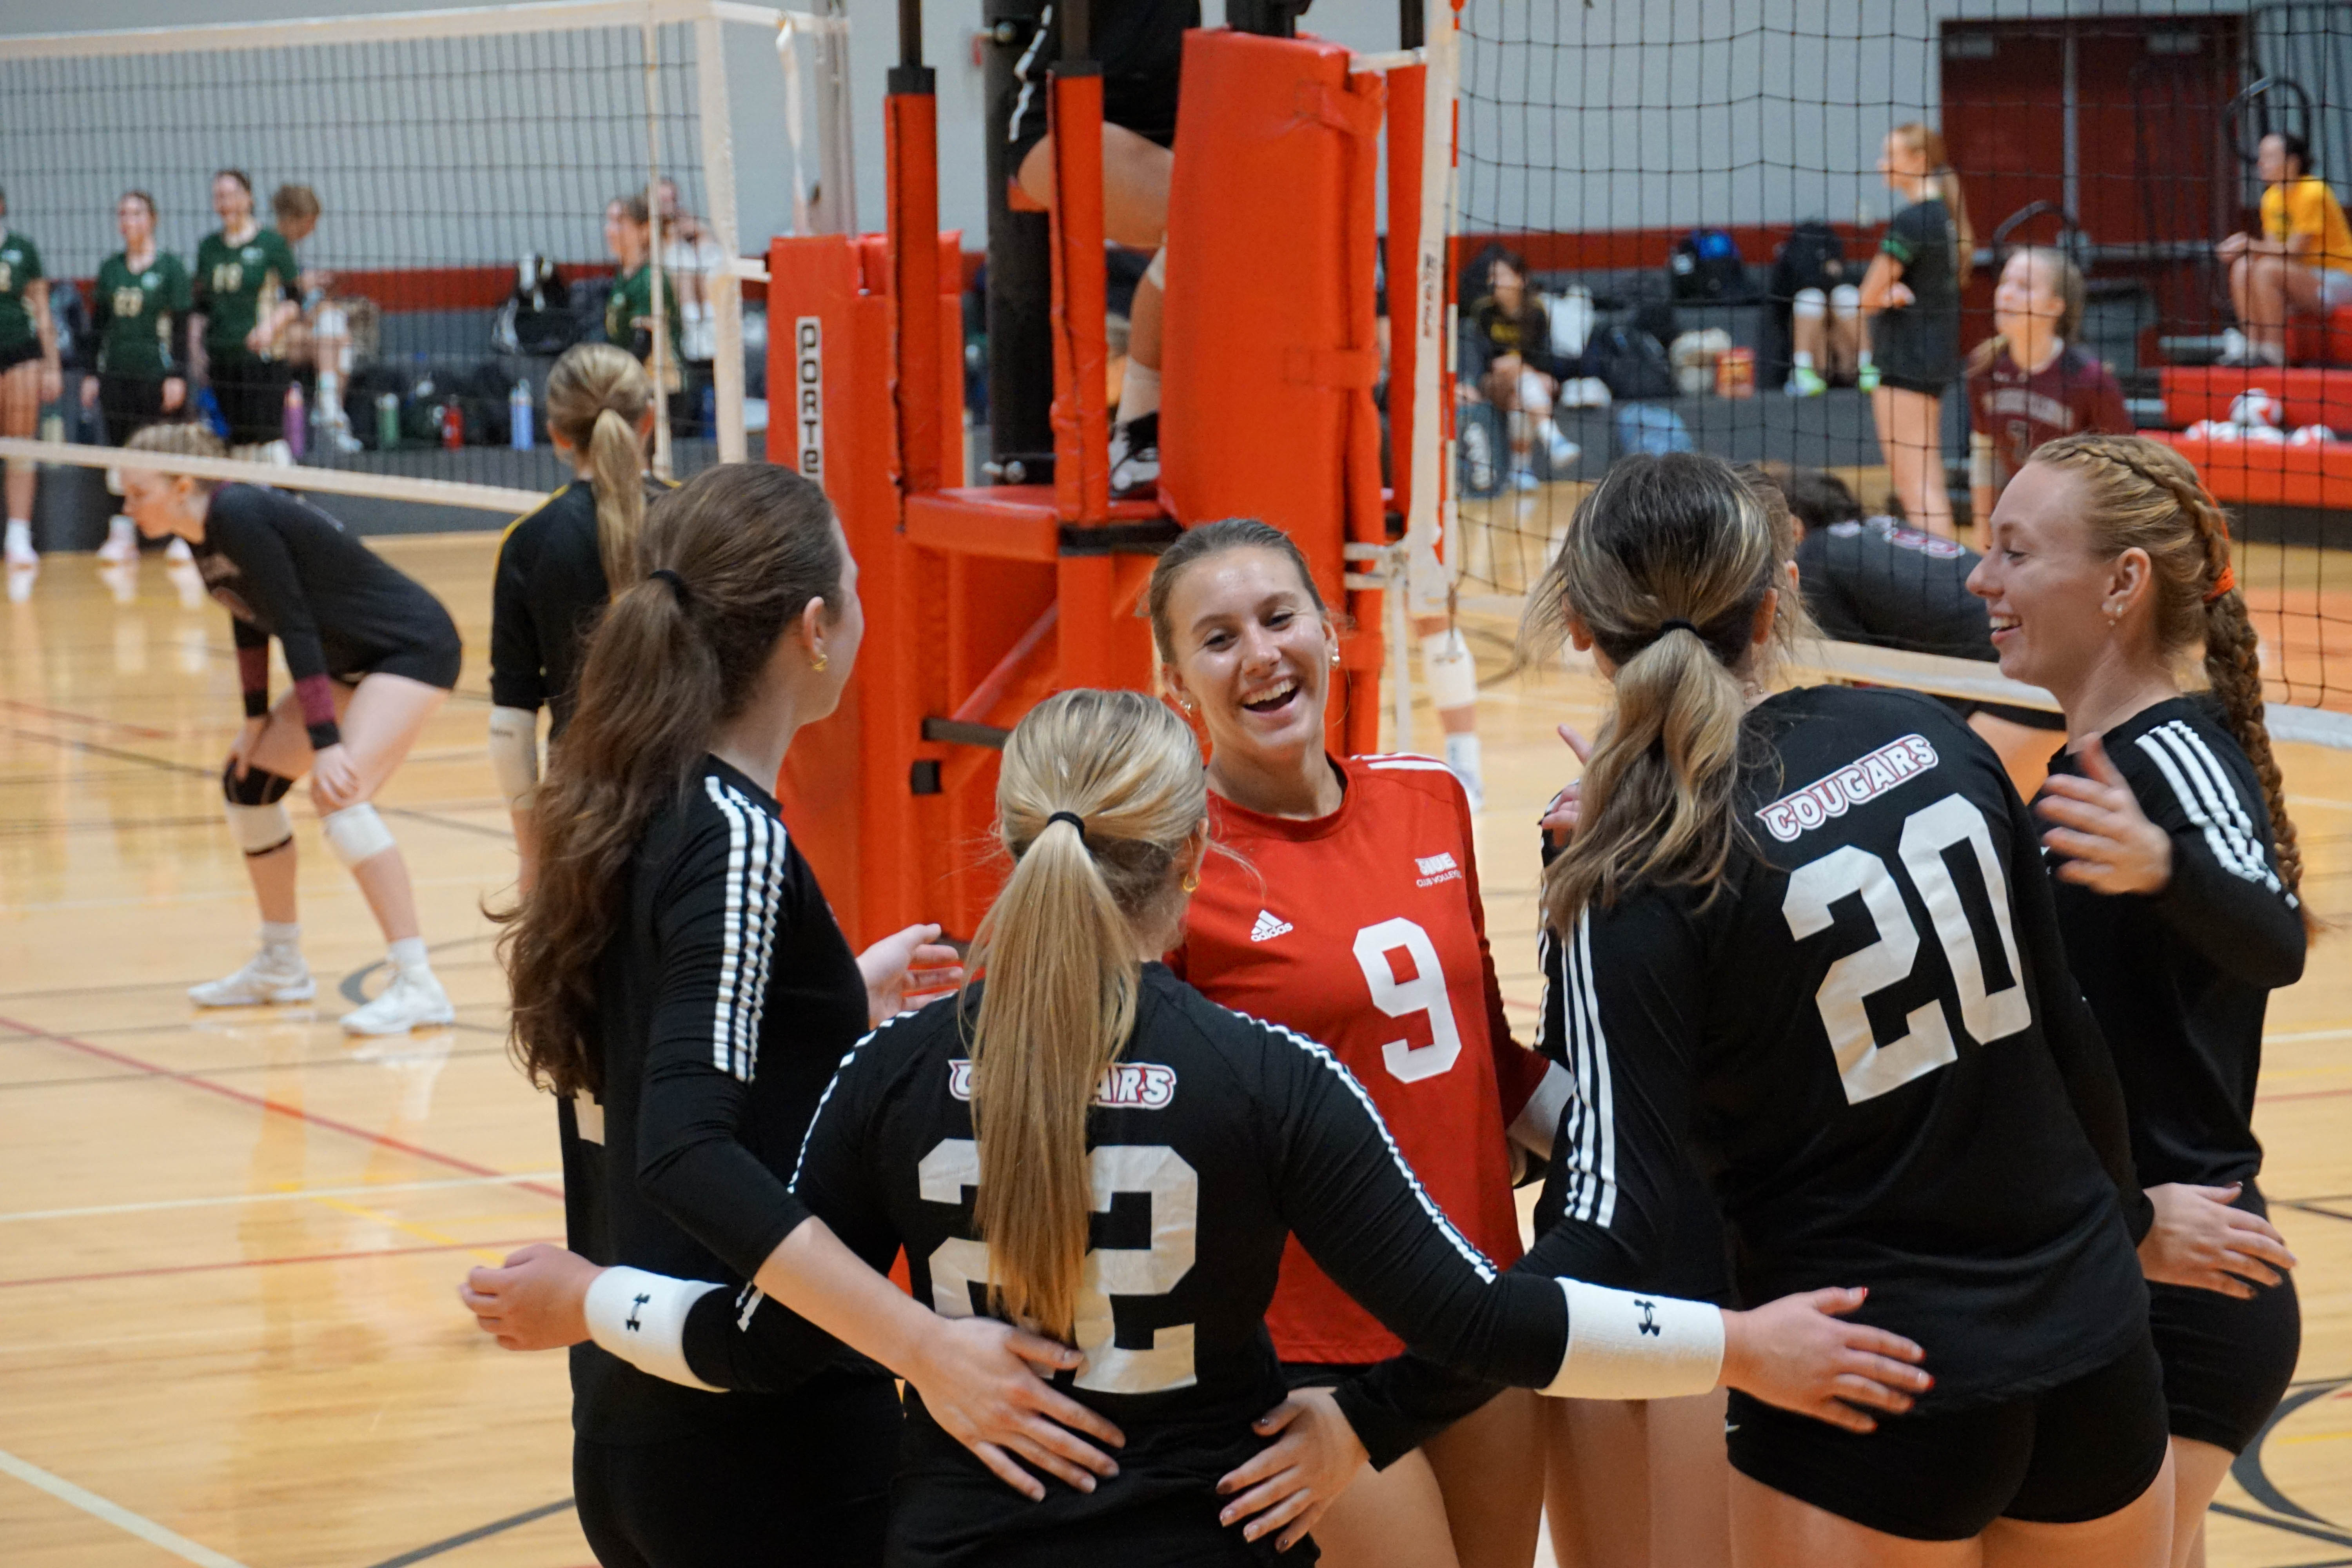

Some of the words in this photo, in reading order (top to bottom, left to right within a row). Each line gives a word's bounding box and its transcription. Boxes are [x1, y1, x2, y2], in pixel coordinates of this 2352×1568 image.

[1759, 735, 1936, 840] COUGARS
[1250, 922, 1293, 942] adidas
[1782, 793, 2032, 1106] 20
[1352, 917, 1462, 1083] 9
